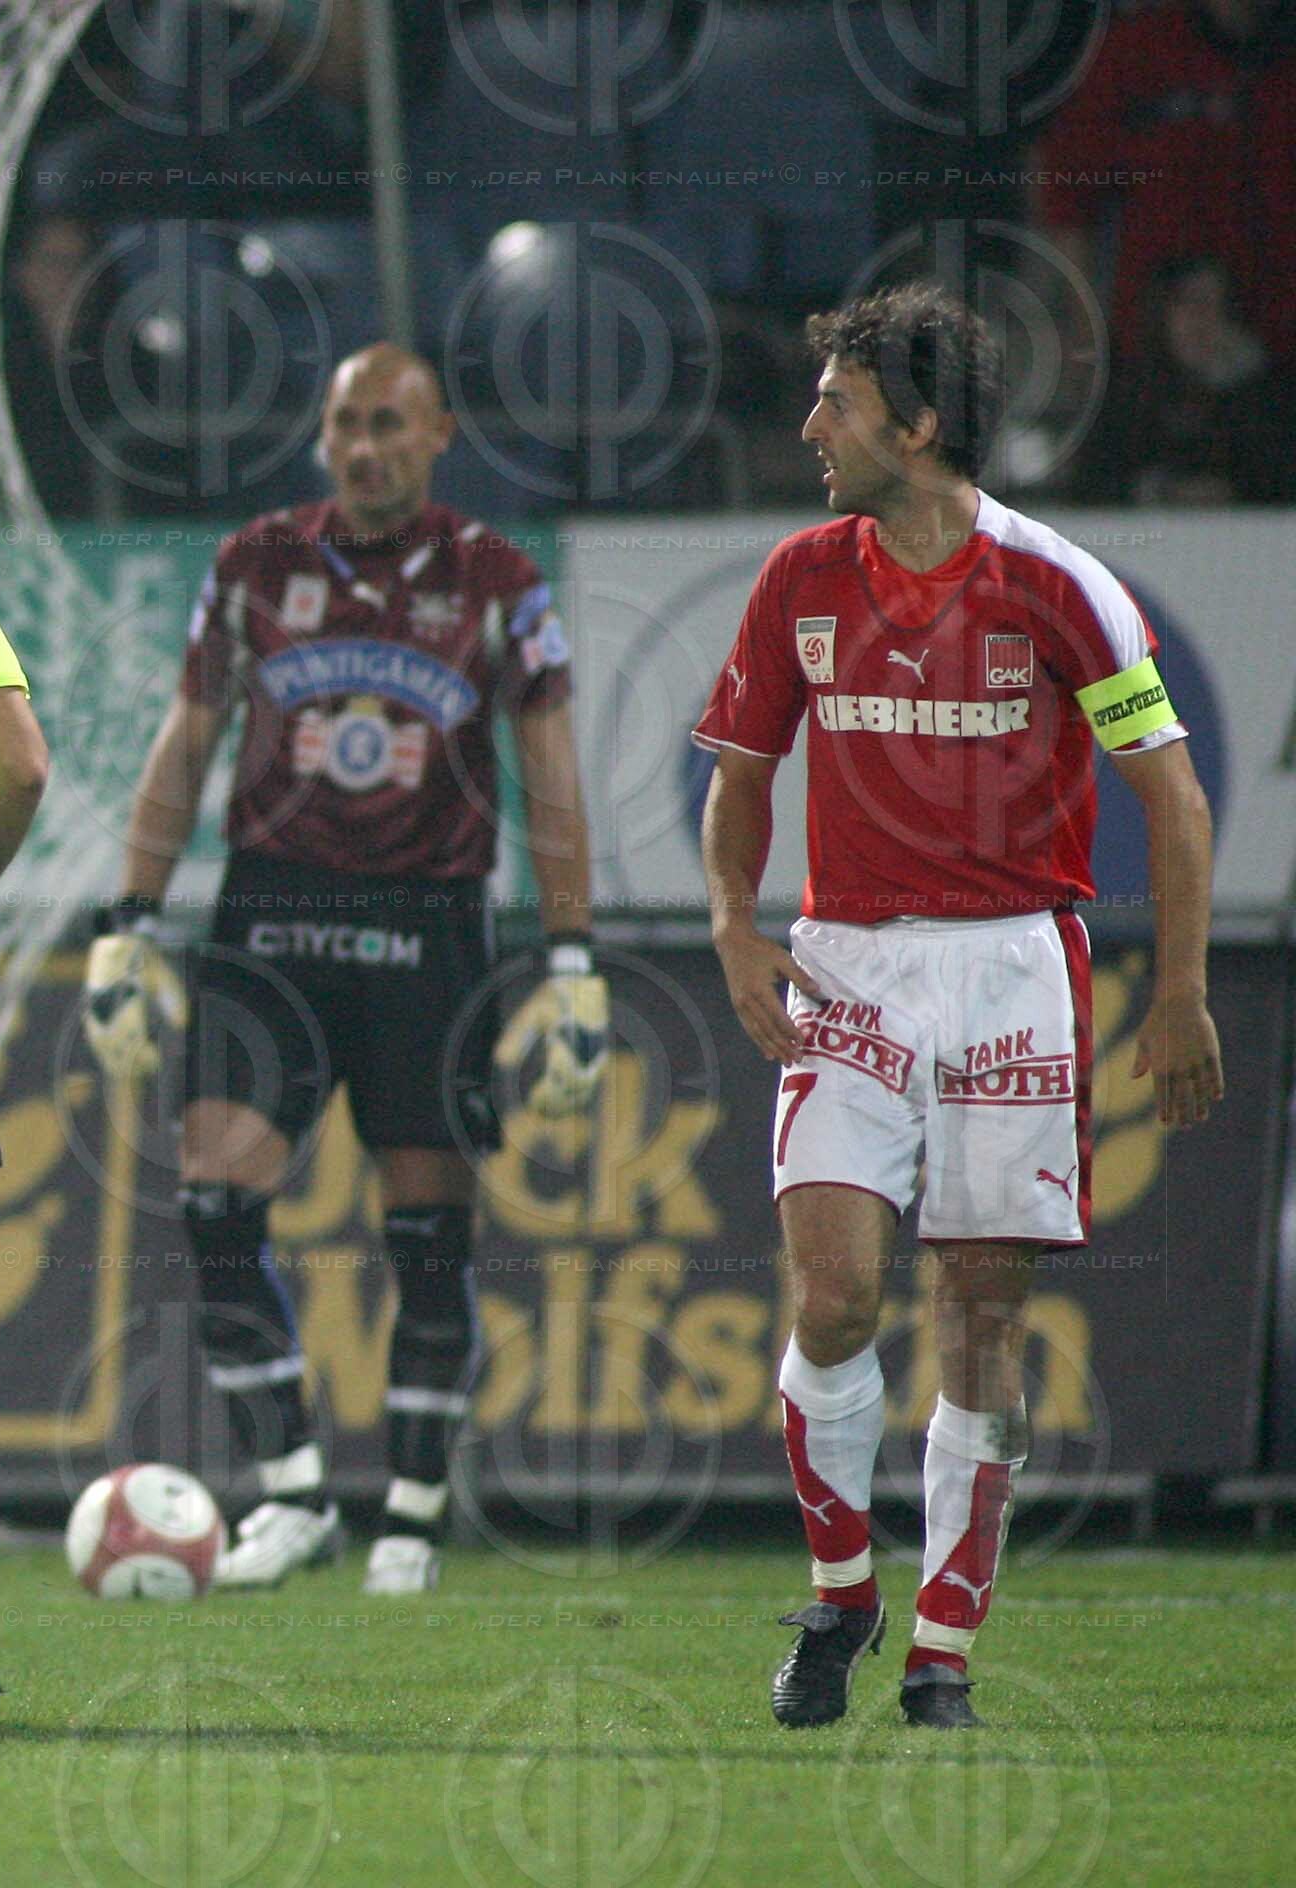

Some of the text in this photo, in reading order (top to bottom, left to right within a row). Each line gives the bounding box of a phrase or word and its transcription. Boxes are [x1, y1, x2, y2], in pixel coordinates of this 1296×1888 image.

[990, 667, 1029, 685] GAK
[816, 693, 1030, 737] LIEBHERR
[249, 923, 422, 968] CITYCOM
[964, 1027, 1035, 1074] TANK
[776, 1073, 818, 1167] 7
